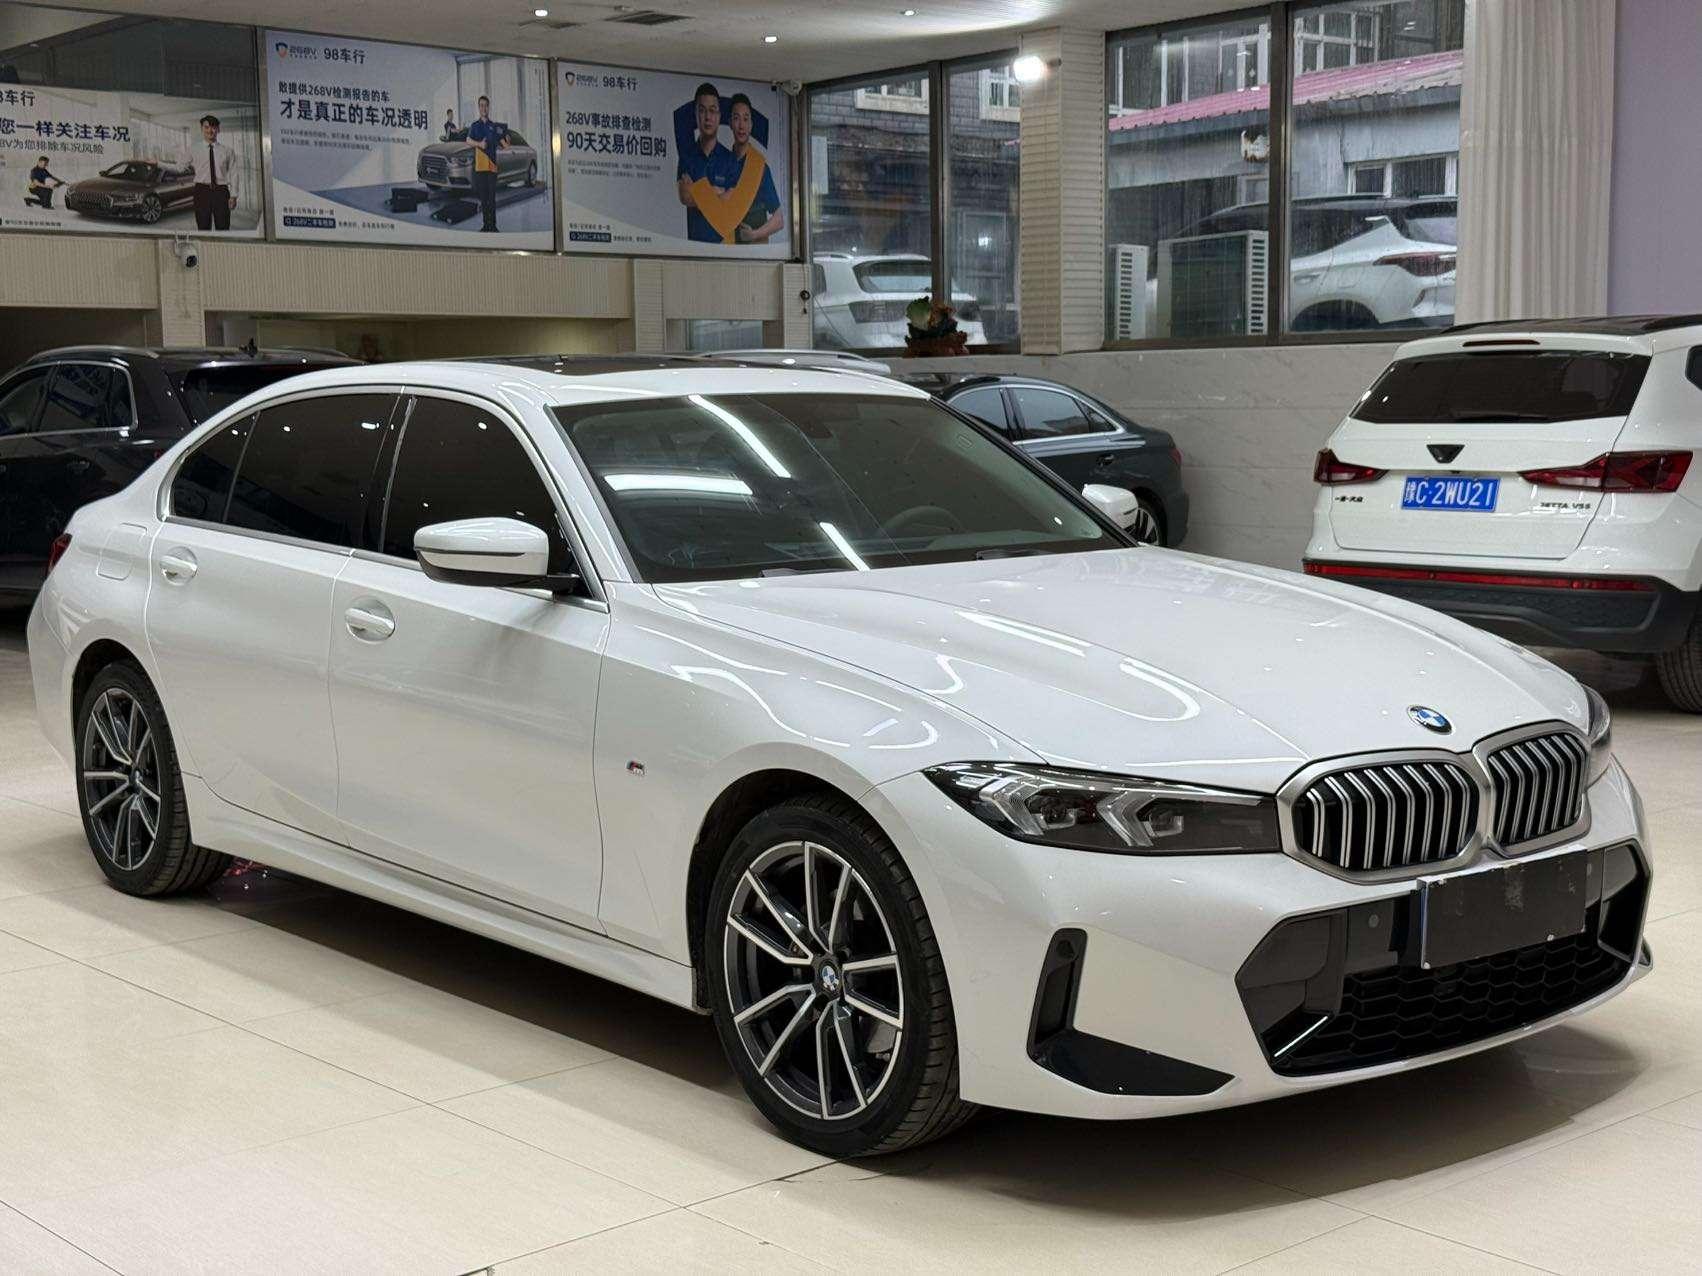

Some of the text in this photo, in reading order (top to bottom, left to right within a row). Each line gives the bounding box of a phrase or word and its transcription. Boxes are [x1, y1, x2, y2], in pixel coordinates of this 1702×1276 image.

[323, 48, 366, 64] 98车行
[603, 76, 638, 91] 98车行
[280, 98, 428, 130] 才是真正的车况透明
[566, 111, 652, 132] 268V事故排查检测
[0, 118, 130, 142] 您一样关注车况
[567, 131, 667, 157] 90天交易价回购
